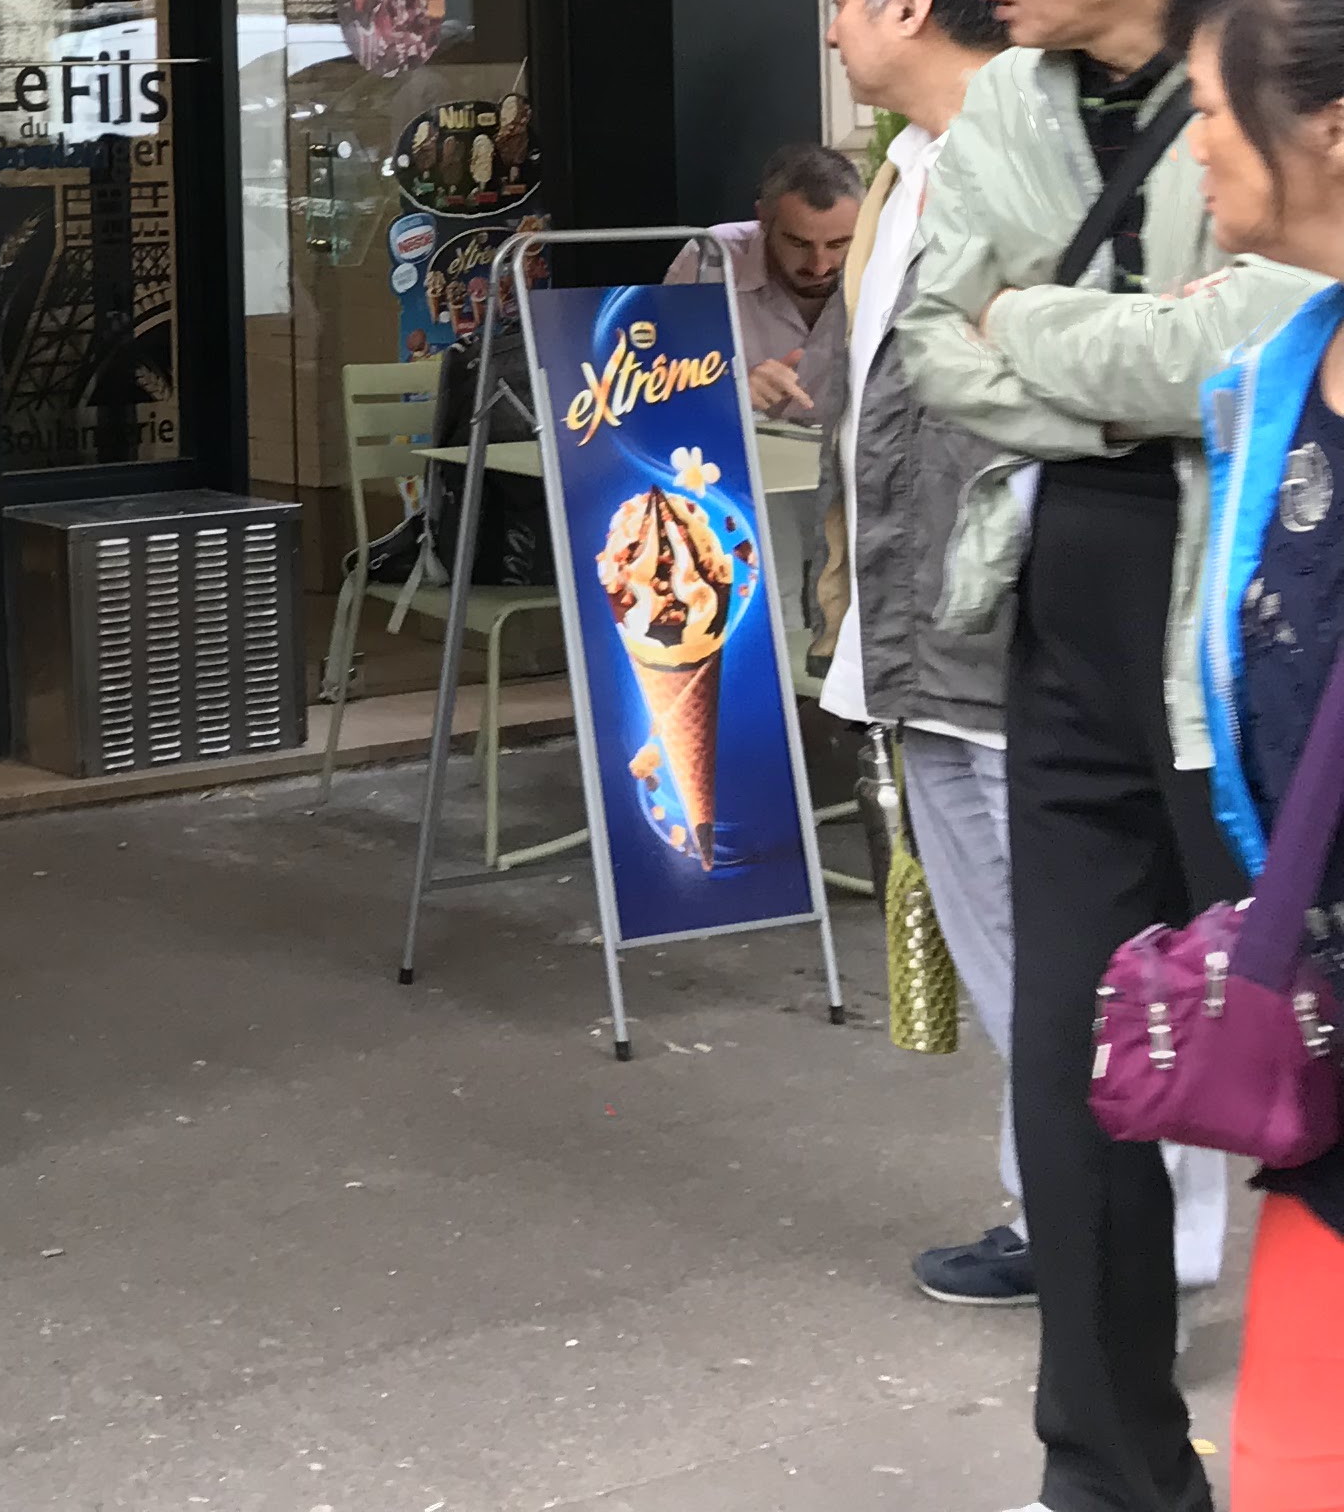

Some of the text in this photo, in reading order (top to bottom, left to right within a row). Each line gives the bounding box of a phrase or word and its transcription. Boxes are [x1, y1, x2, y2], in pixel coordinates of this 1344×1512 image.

[61, 49, 169, 125] Fils
[19, 116, 50, 139] du
[560, 326, 728, 447] eXtrême
